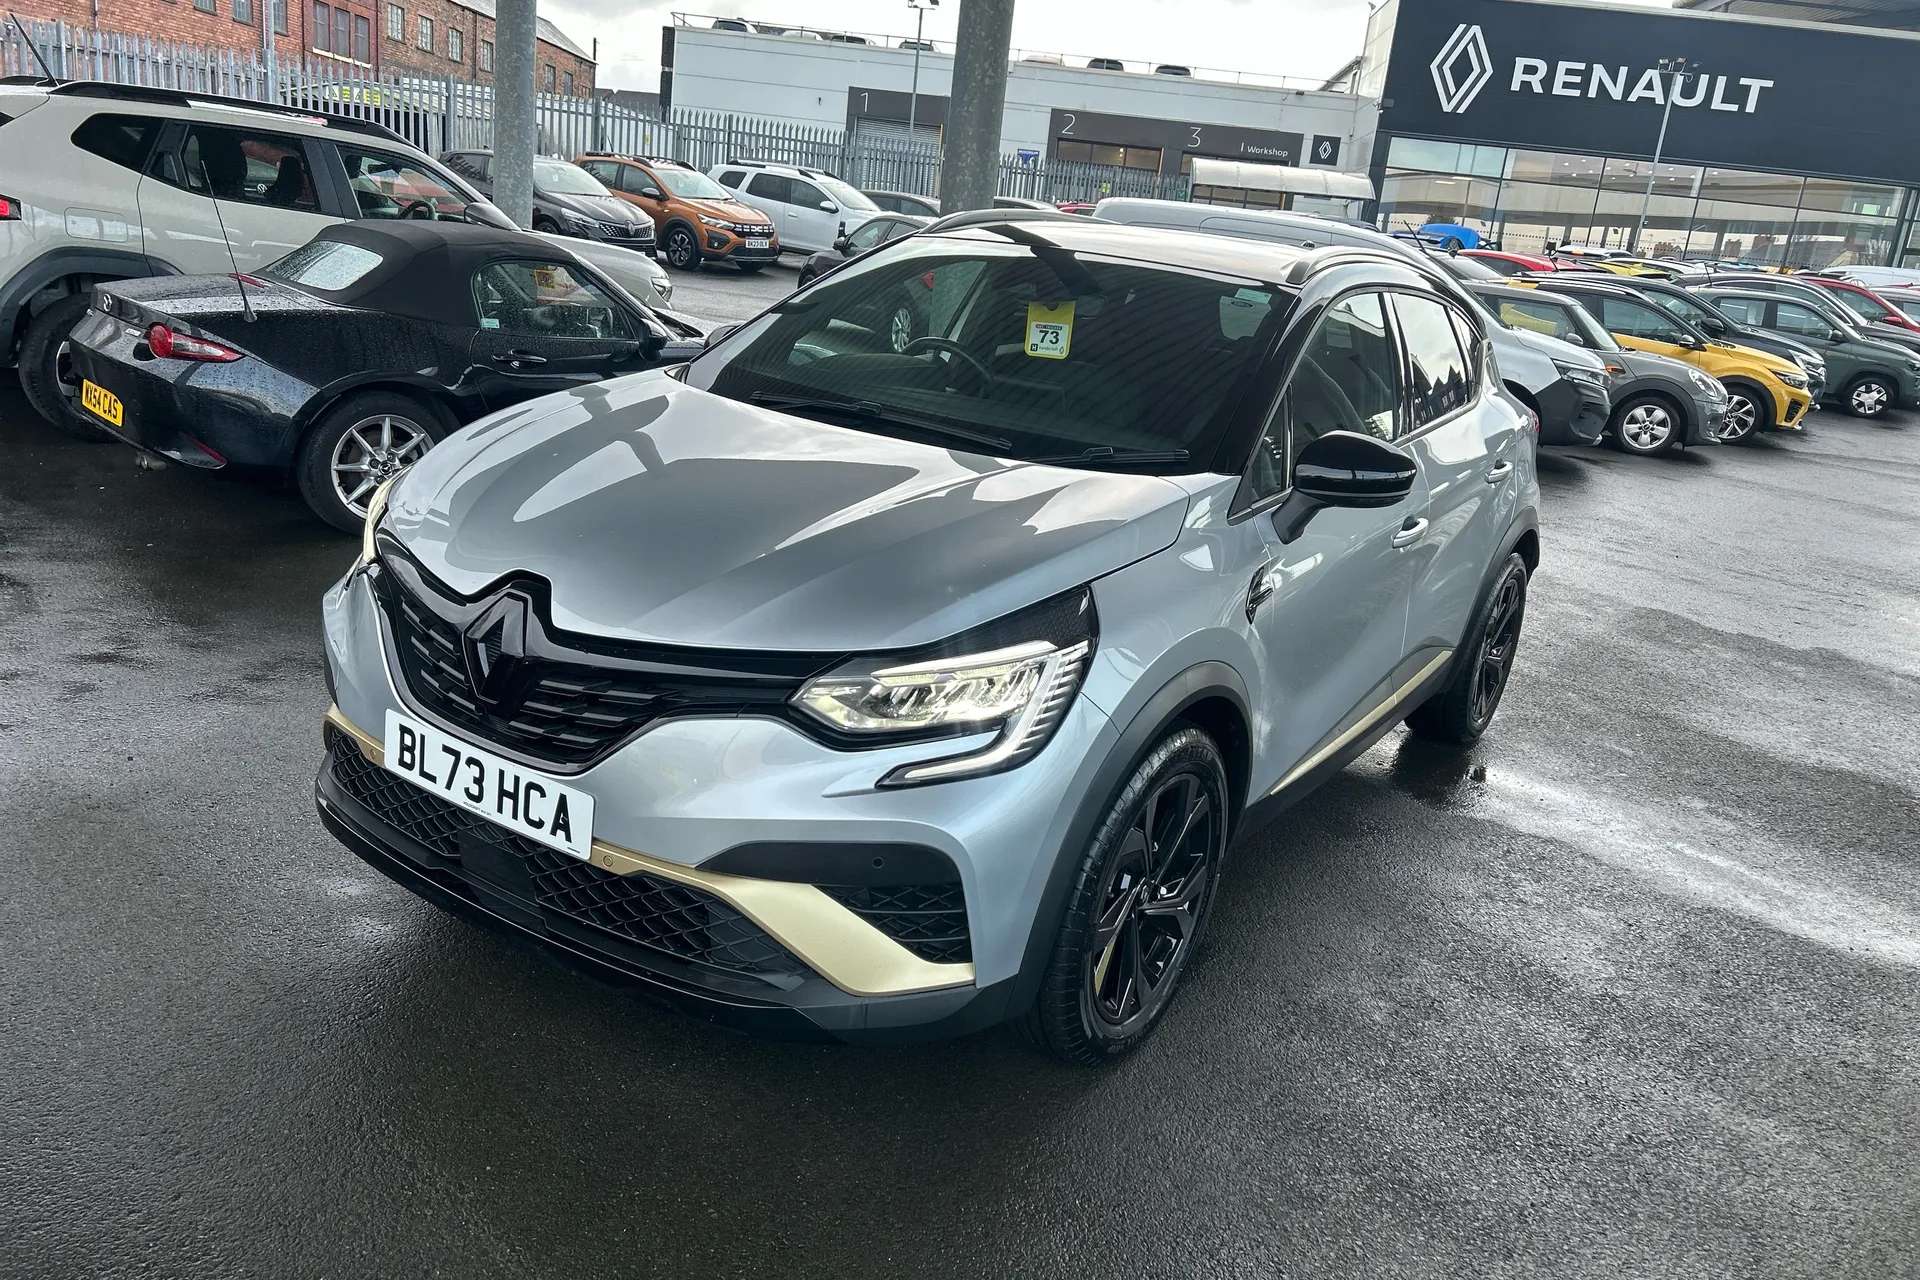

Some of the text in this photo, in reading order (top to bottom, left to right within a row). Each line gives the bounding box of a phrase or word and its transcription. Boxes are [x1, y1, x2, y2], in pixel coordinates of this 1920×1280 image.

[1510, 56, 1775, 114] RENAULT
[860, 92, 869, 113] 1
[1061, 113, 1076, 135] 2
[1187, 126, 1201, 148] 3
[1247, 145, 1288, 158] Workshop
[1039, 329, 1060, 345] 73
[102, 393, 119, 420] CAS
[398, 723, 572, 844] BL73 HCA
